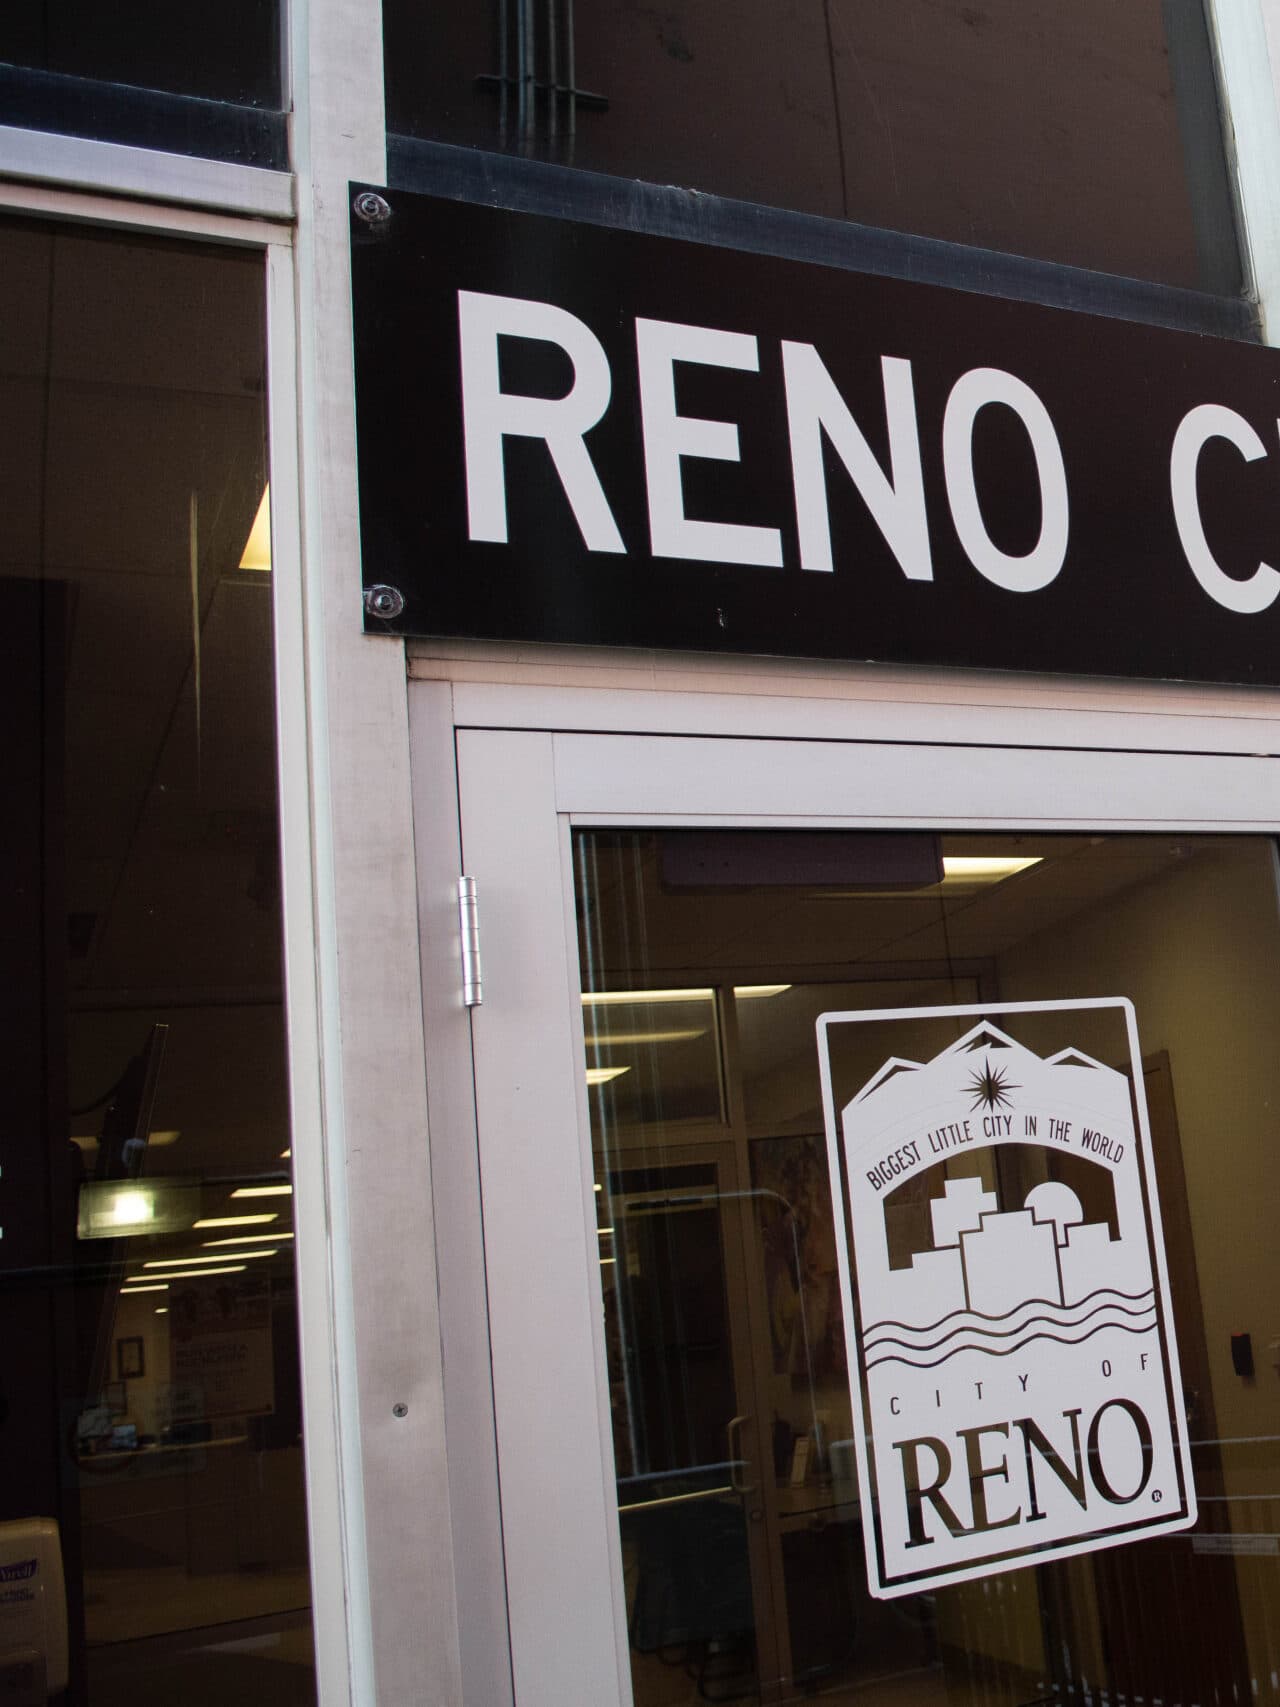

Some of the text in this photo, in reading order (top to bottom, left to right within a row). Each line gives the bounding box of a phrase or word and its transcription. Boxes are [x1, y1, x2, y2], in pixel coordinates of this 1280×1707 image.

[458, 290, 1069, 592] RENO
[866, 1115, 1124, 1191] BIGGEST LITTLE CITY IN THE WORLD
[890, 1353, 1149, 1415] CITY OF
